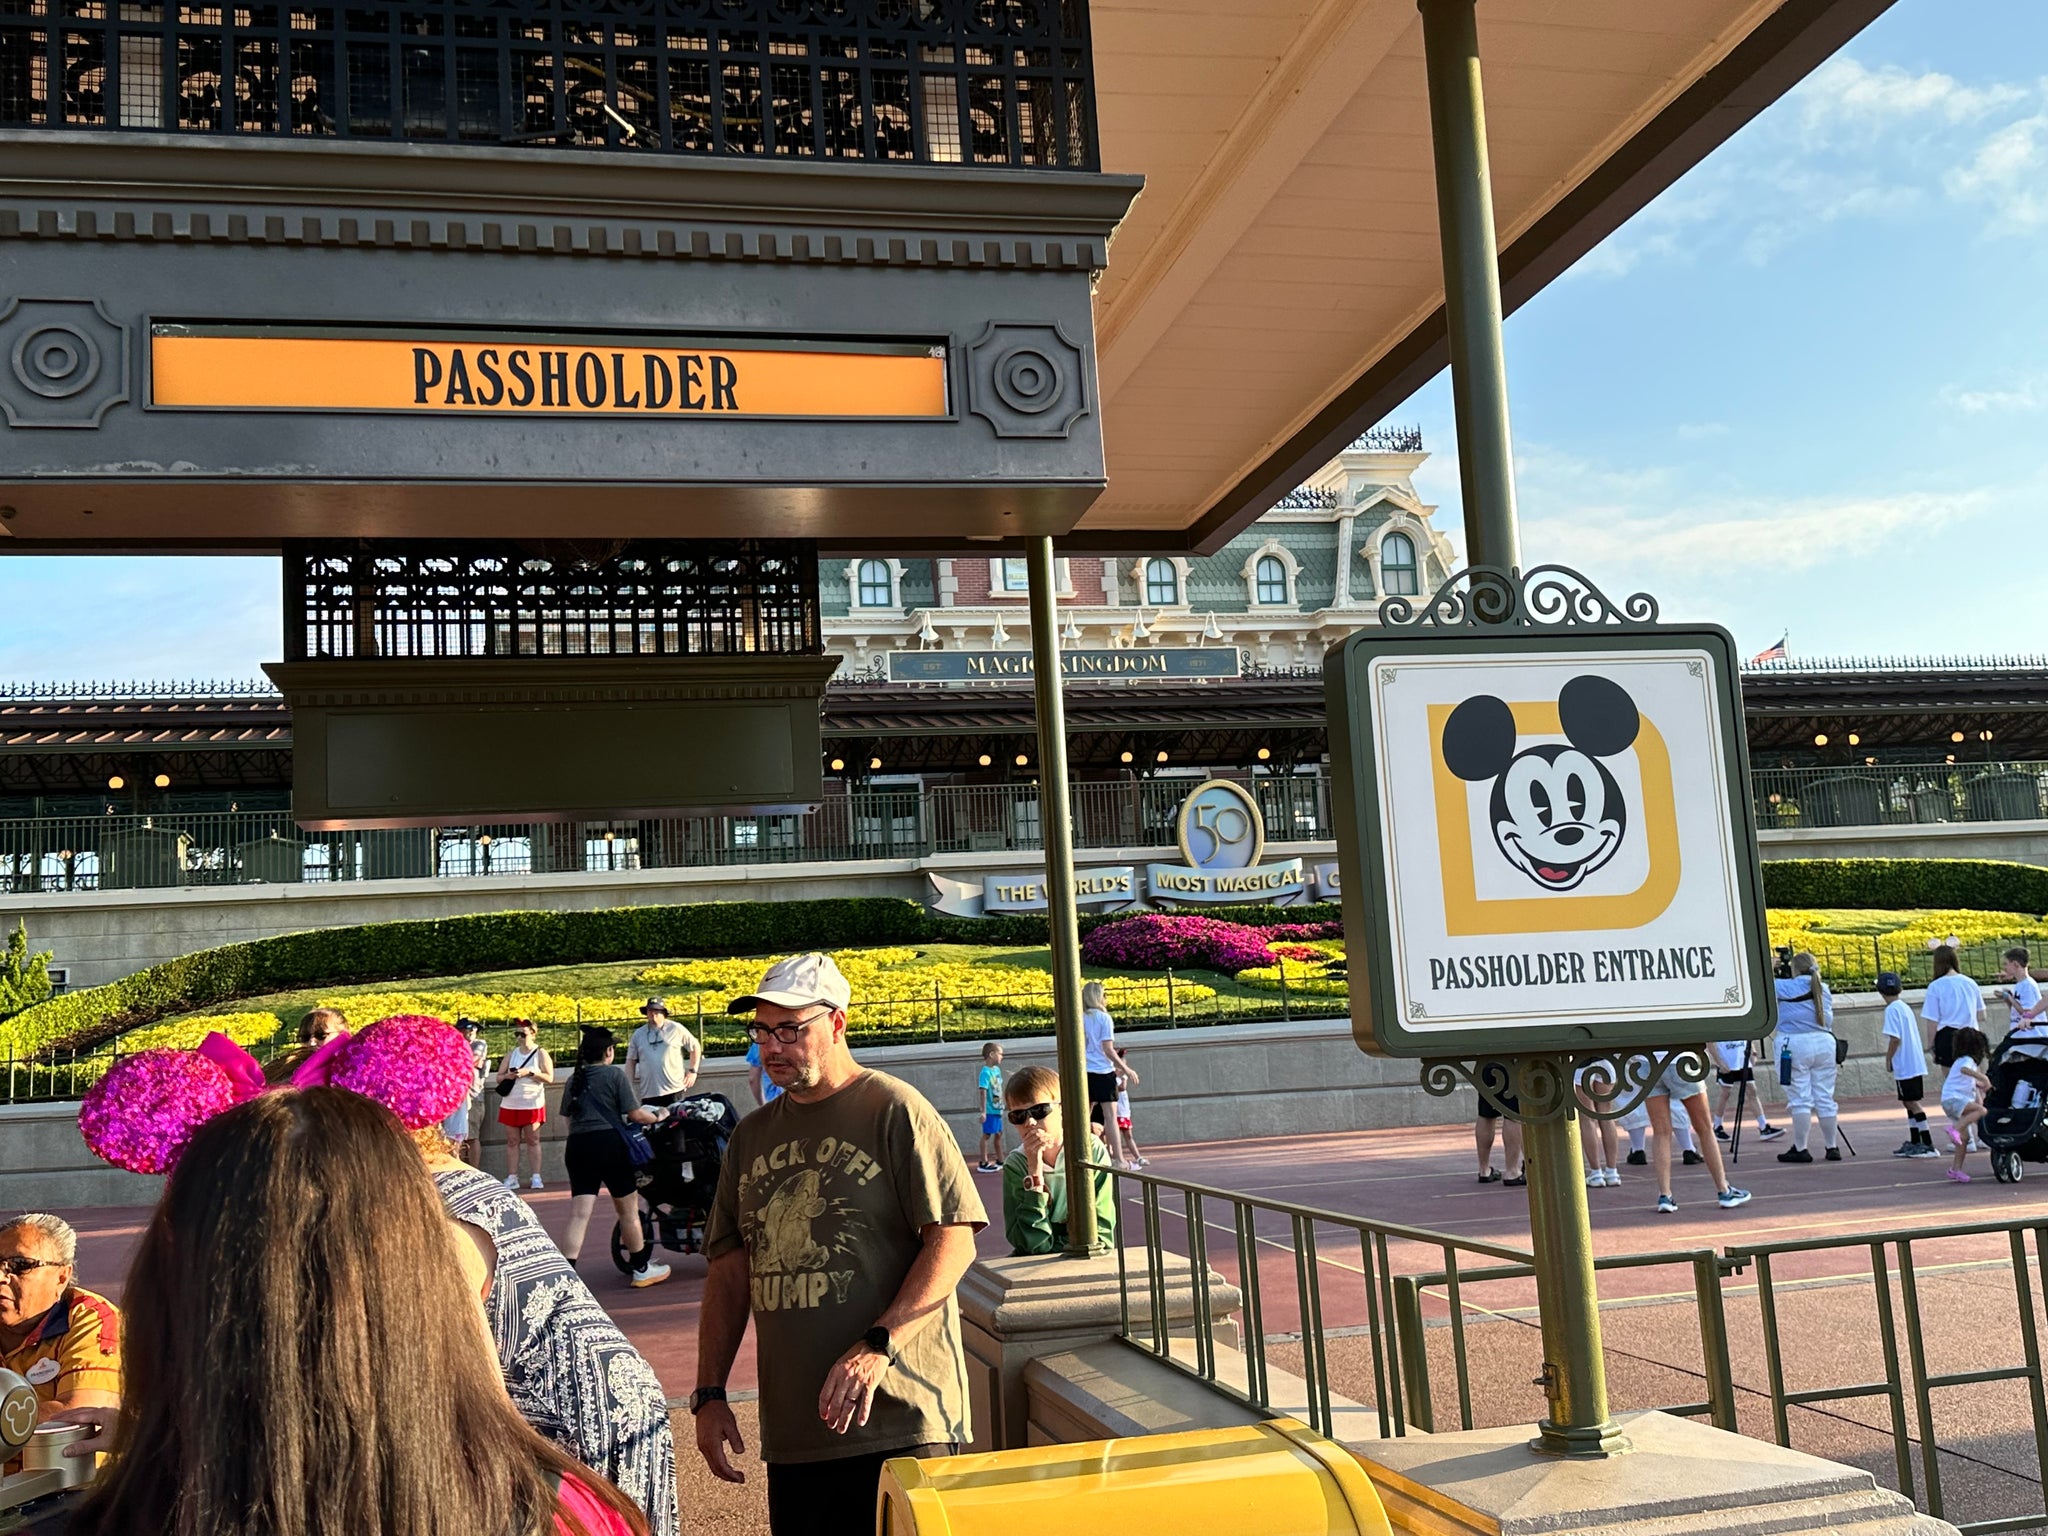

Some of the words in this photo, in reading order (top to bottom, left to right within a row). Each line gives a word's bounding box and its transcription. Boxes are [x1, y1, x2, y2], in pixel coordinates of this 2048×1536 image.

[412, 348, 739, 410] PASSHOLDER
[966, 655, 1034, 675] MAGI
[1195, 804, 1250, 864] 50
[996, 884, 1037, 902] THE
[1041, 875, 1131, 899] RLD'S
[1156, 872, 1211, 892] MOST
[1216, 868, 1304, 892] MAGICAL
[1429, 952, 1586, 990] PASSHOLDER
[1593, 946, 1716, 982] ENTRANCE
[816, 1137, 883, 1186] OFF!
[750, 1269, 855, 1312] RUMPY
